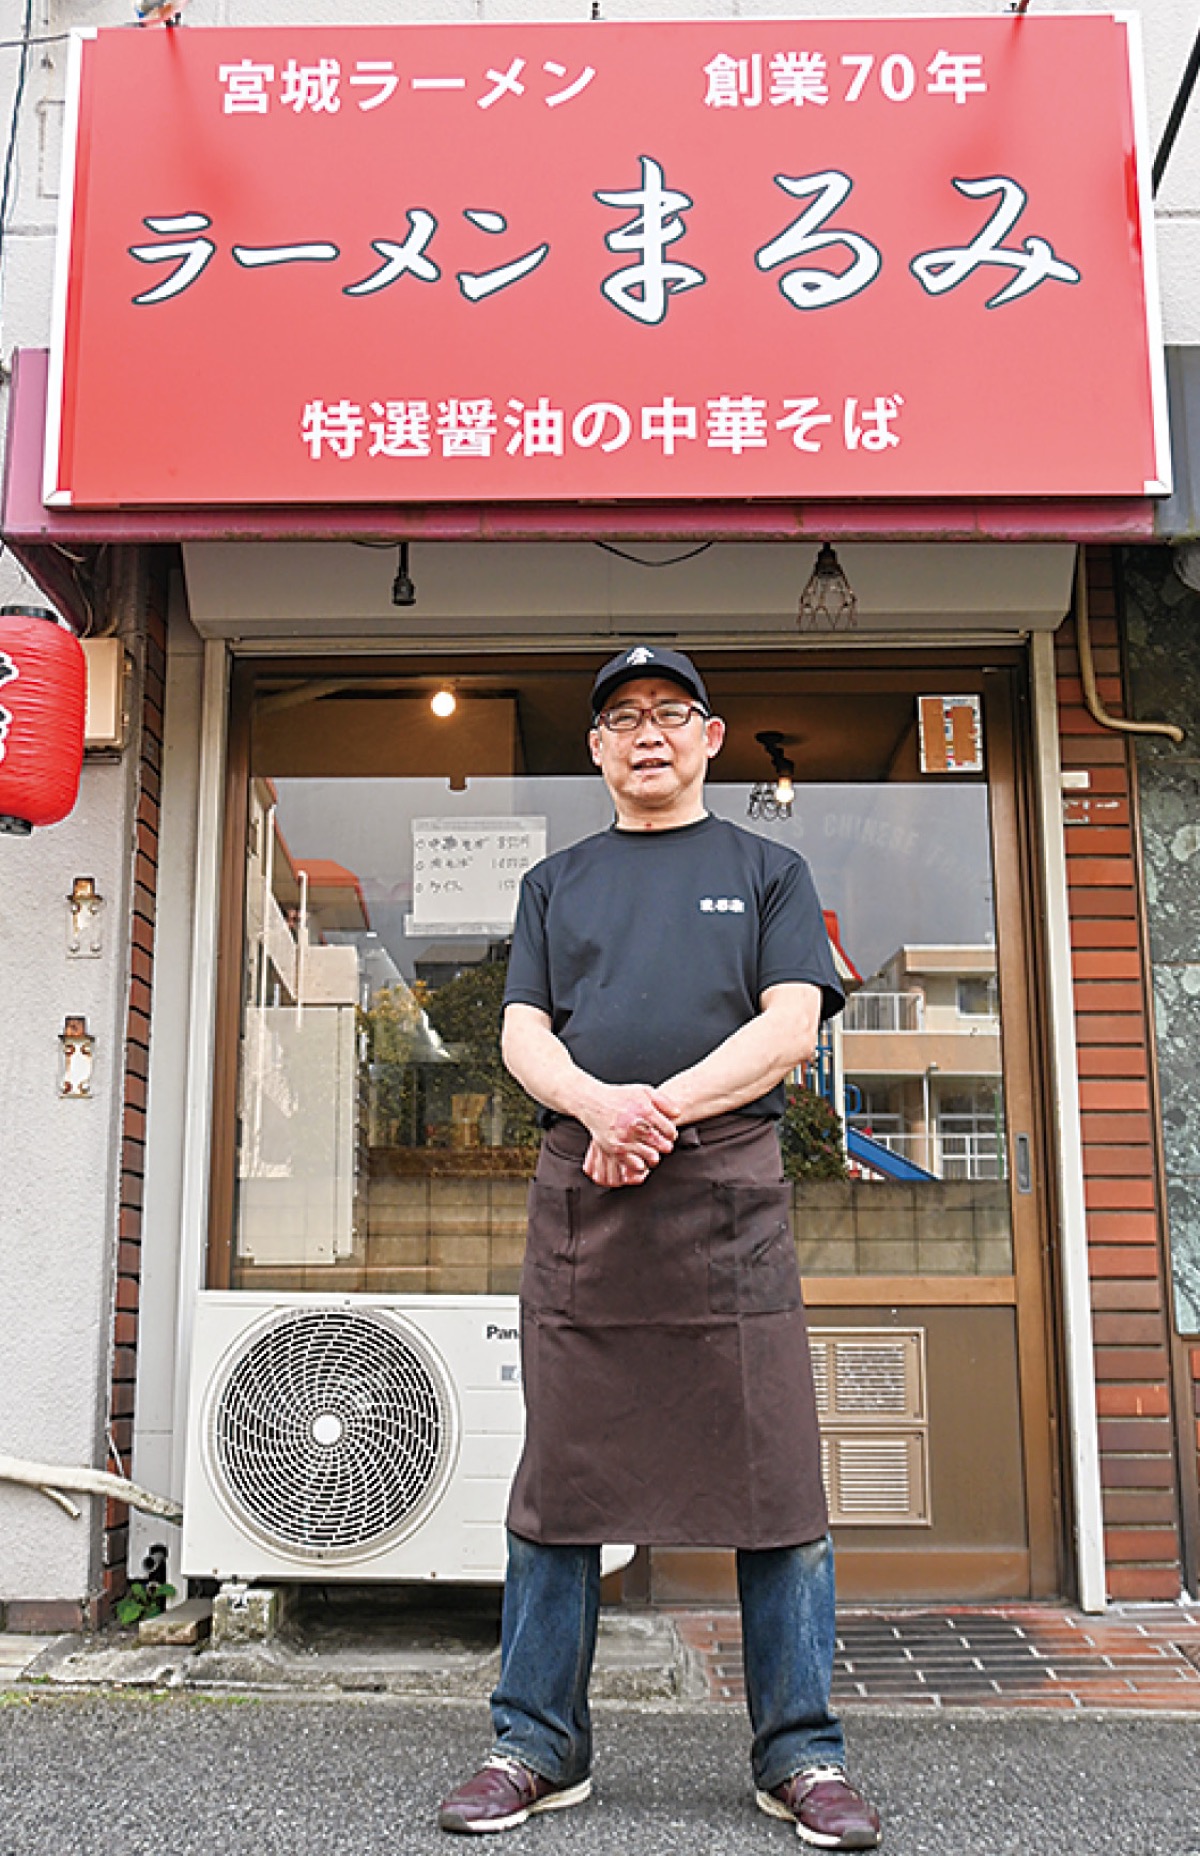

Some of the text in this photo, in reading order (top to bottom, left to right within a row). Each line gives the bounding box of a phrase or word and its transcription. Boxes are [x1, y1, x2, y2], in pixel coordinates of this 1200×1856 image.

[218, 49, 988, 114] 宮城ラーメン 創業70年
[127, 154, 1081, 325] ラーメン まるみ
[300, 393, 905, 460] 特選醤油の中華そば
